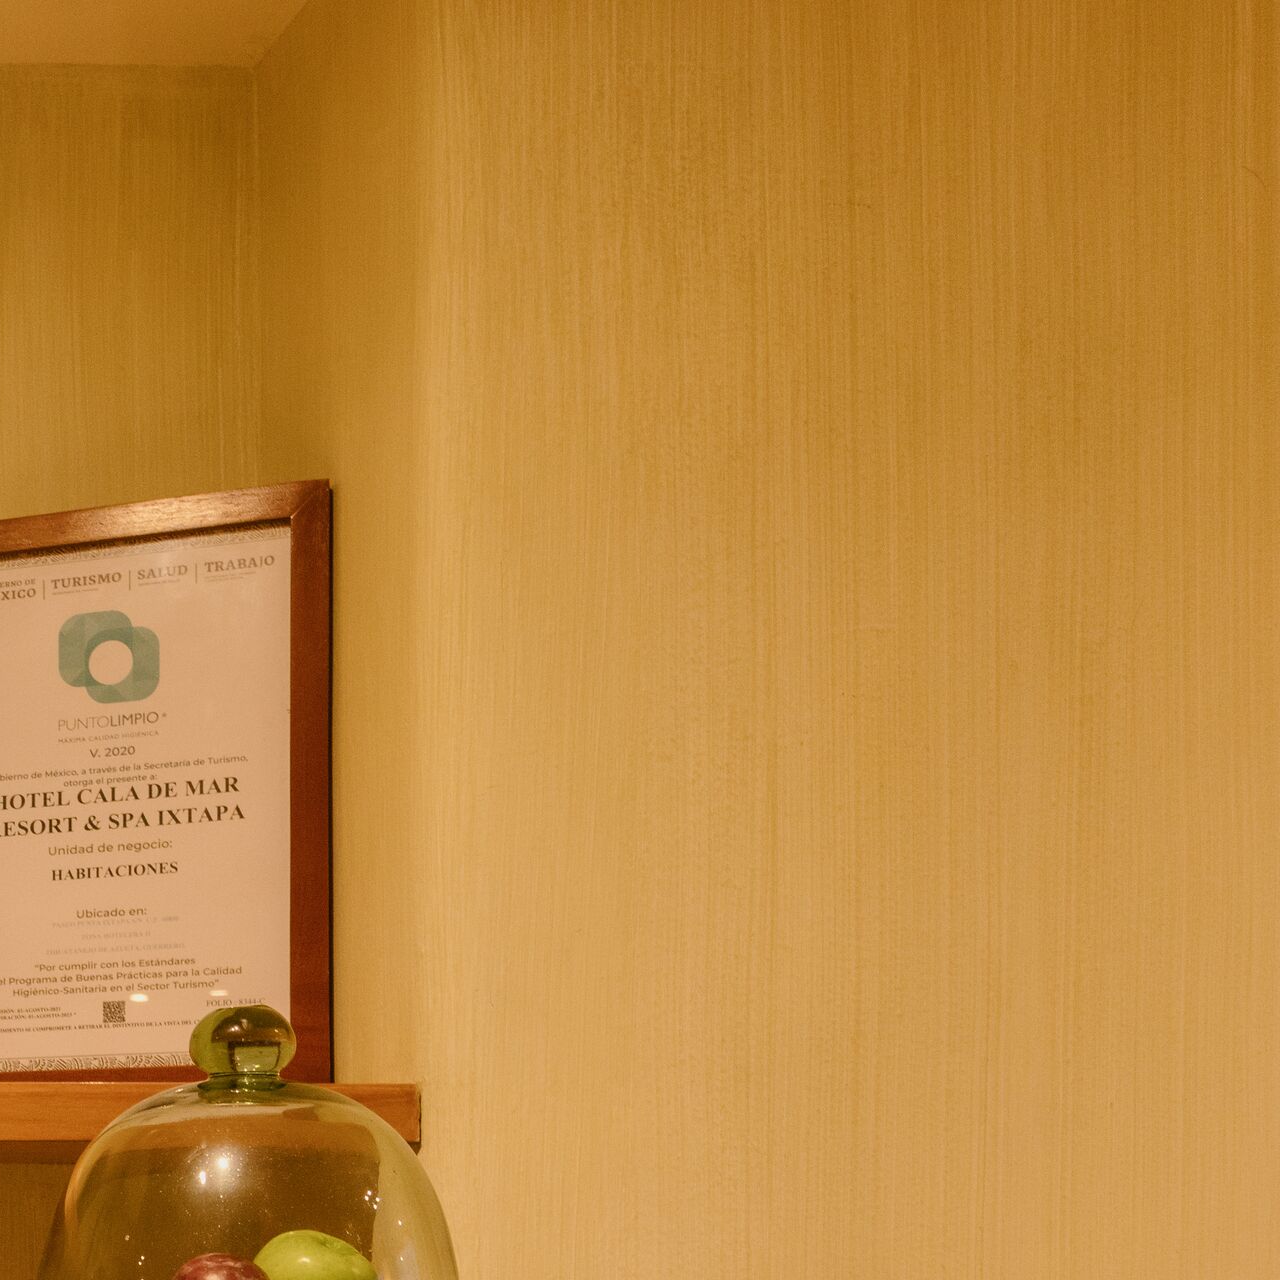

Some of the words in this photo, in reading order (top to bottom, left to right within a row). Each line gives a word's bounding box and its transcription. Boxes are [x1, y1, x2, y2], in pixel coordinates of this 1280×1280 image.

[51, 572, 122, 589] TURISMO
[137, 565, 188, 580] SALUD
[204, 555, 275, 572] TRABAJO
[58, 711, 159, 731] PUNTOLIMPIO
[90, 749, 101, 758] V.
[105, 746, 136, 757] 2020
[31, 771, 42, 779] de
[45, 770, 78, 778] México,
[89, 766, 117, 774] través
[193, 758, 205, 766] de
[208, 755, 248, 765] Turismo,
[64, 777, 93, 787] otorga
[106, 774, 147, 785] presente
[77, 785, 139, 804] CALA
[148, 782, 177, 799] DE
[186, 776, 239, 796] MAR
[84, 815, 101, 831] &
[108, 812, 150, 829] SPA
[158, 804, 245, 826] IXTAPA
[48, 844, 94, 856] Unidad
[98, 843, 114, 853] de
[118, 839, 172, 852] negocio:
[52, 861, 178, 881] HABITACIONES
[76, 908, 126, 919] Ubicado
[129, 908, 147, 916] en:
[59, 961, 97, 971] cumplir
[100, 961, 119, 969] con
[139, 958, 196, 966] Estándares
[9, 976, 57, 986] Programa
[76, 973, 113, 982] Buenas
[116, 971, 162, 979] Prácticas
[166, 970, 188, 978] para
[203, 966, 242, 976] Calidad
[13, 984, 107, 998] Higiénico-Sanitaria
[137, 982, 170, 990] Sector
